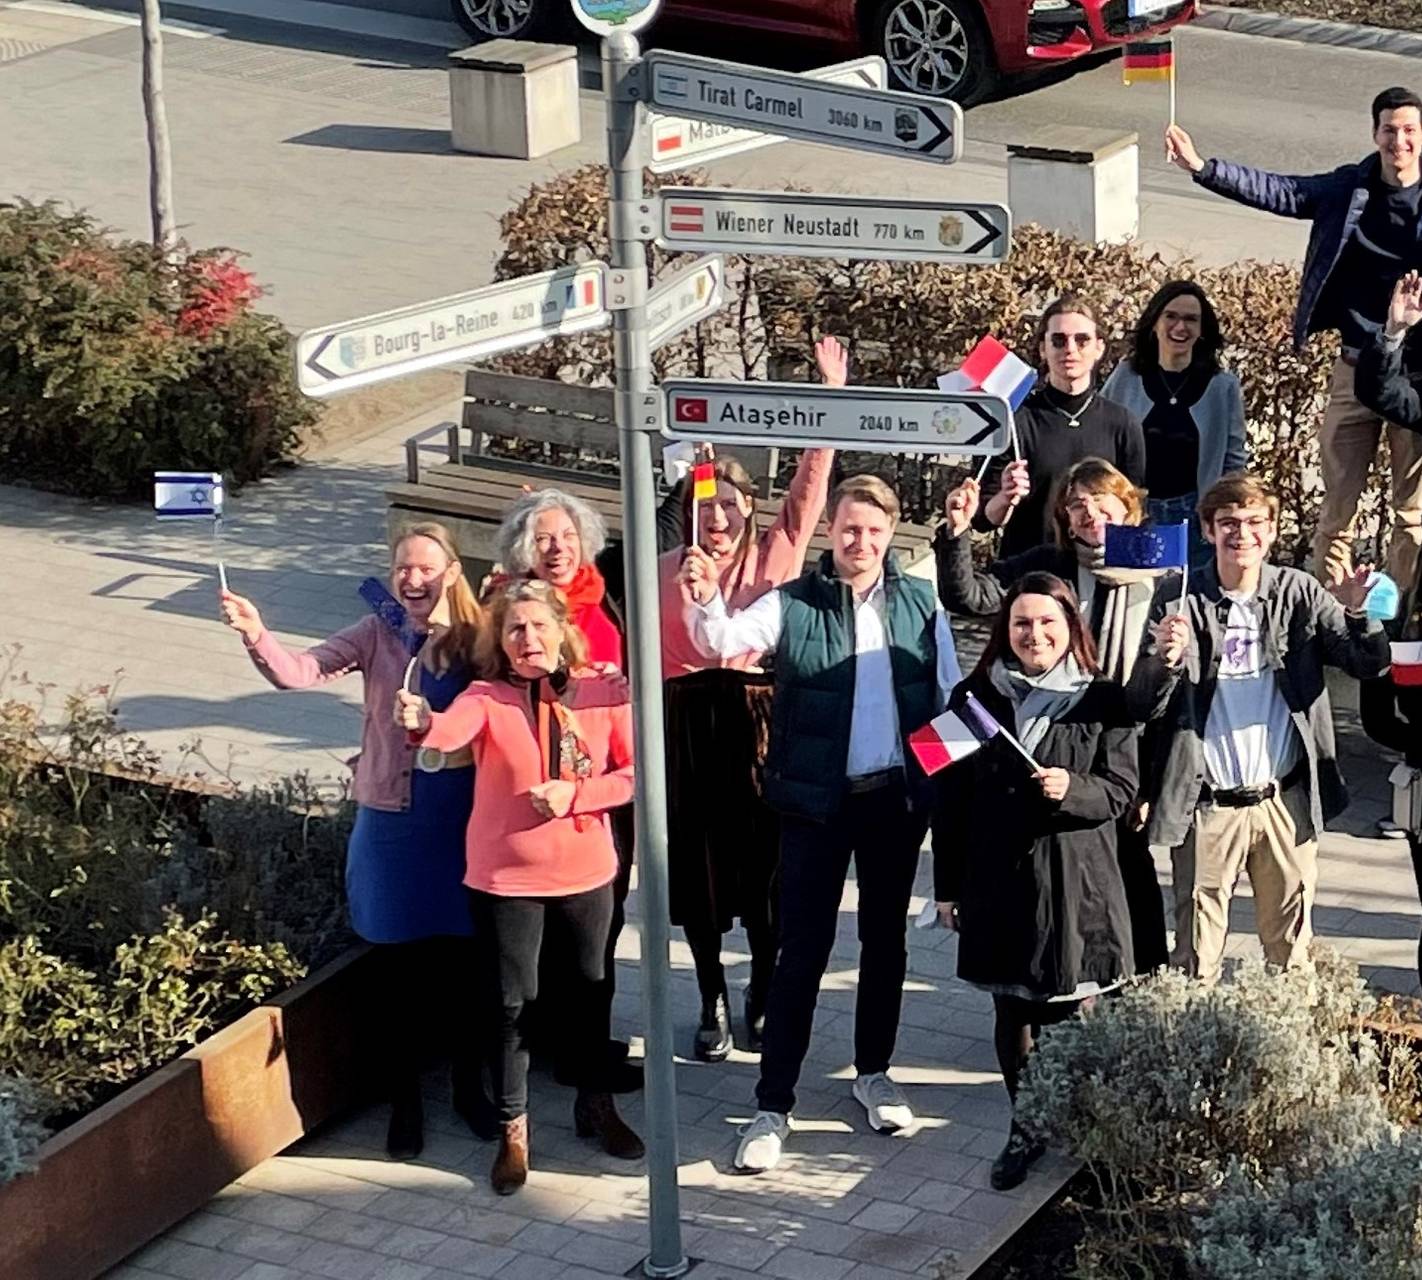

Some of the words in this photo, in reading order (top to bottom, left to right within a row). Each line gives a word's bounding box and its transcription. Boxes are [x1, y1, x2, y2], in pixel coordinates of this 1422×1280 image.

[698, 80, 736, 107] Tirat
[744, 89, 803, 118] Carmel
[828, 108, 858, 128] 3060
[863, 114, 882, 132] km
[716, 210, 774, 233] Wiener
[784, 214, 859, 238] Neustadt
[873, 223, 897, 239] 770
[904, 225, 924, 240] km
[374, 311, 498, 355] Bourg-la-Reine
[512, 302, 534, 320] 420
[720, 403, 827, 430] Ataşehir
[859, 415, 892, 431] 2040
[899, 417, 919, 432] km
